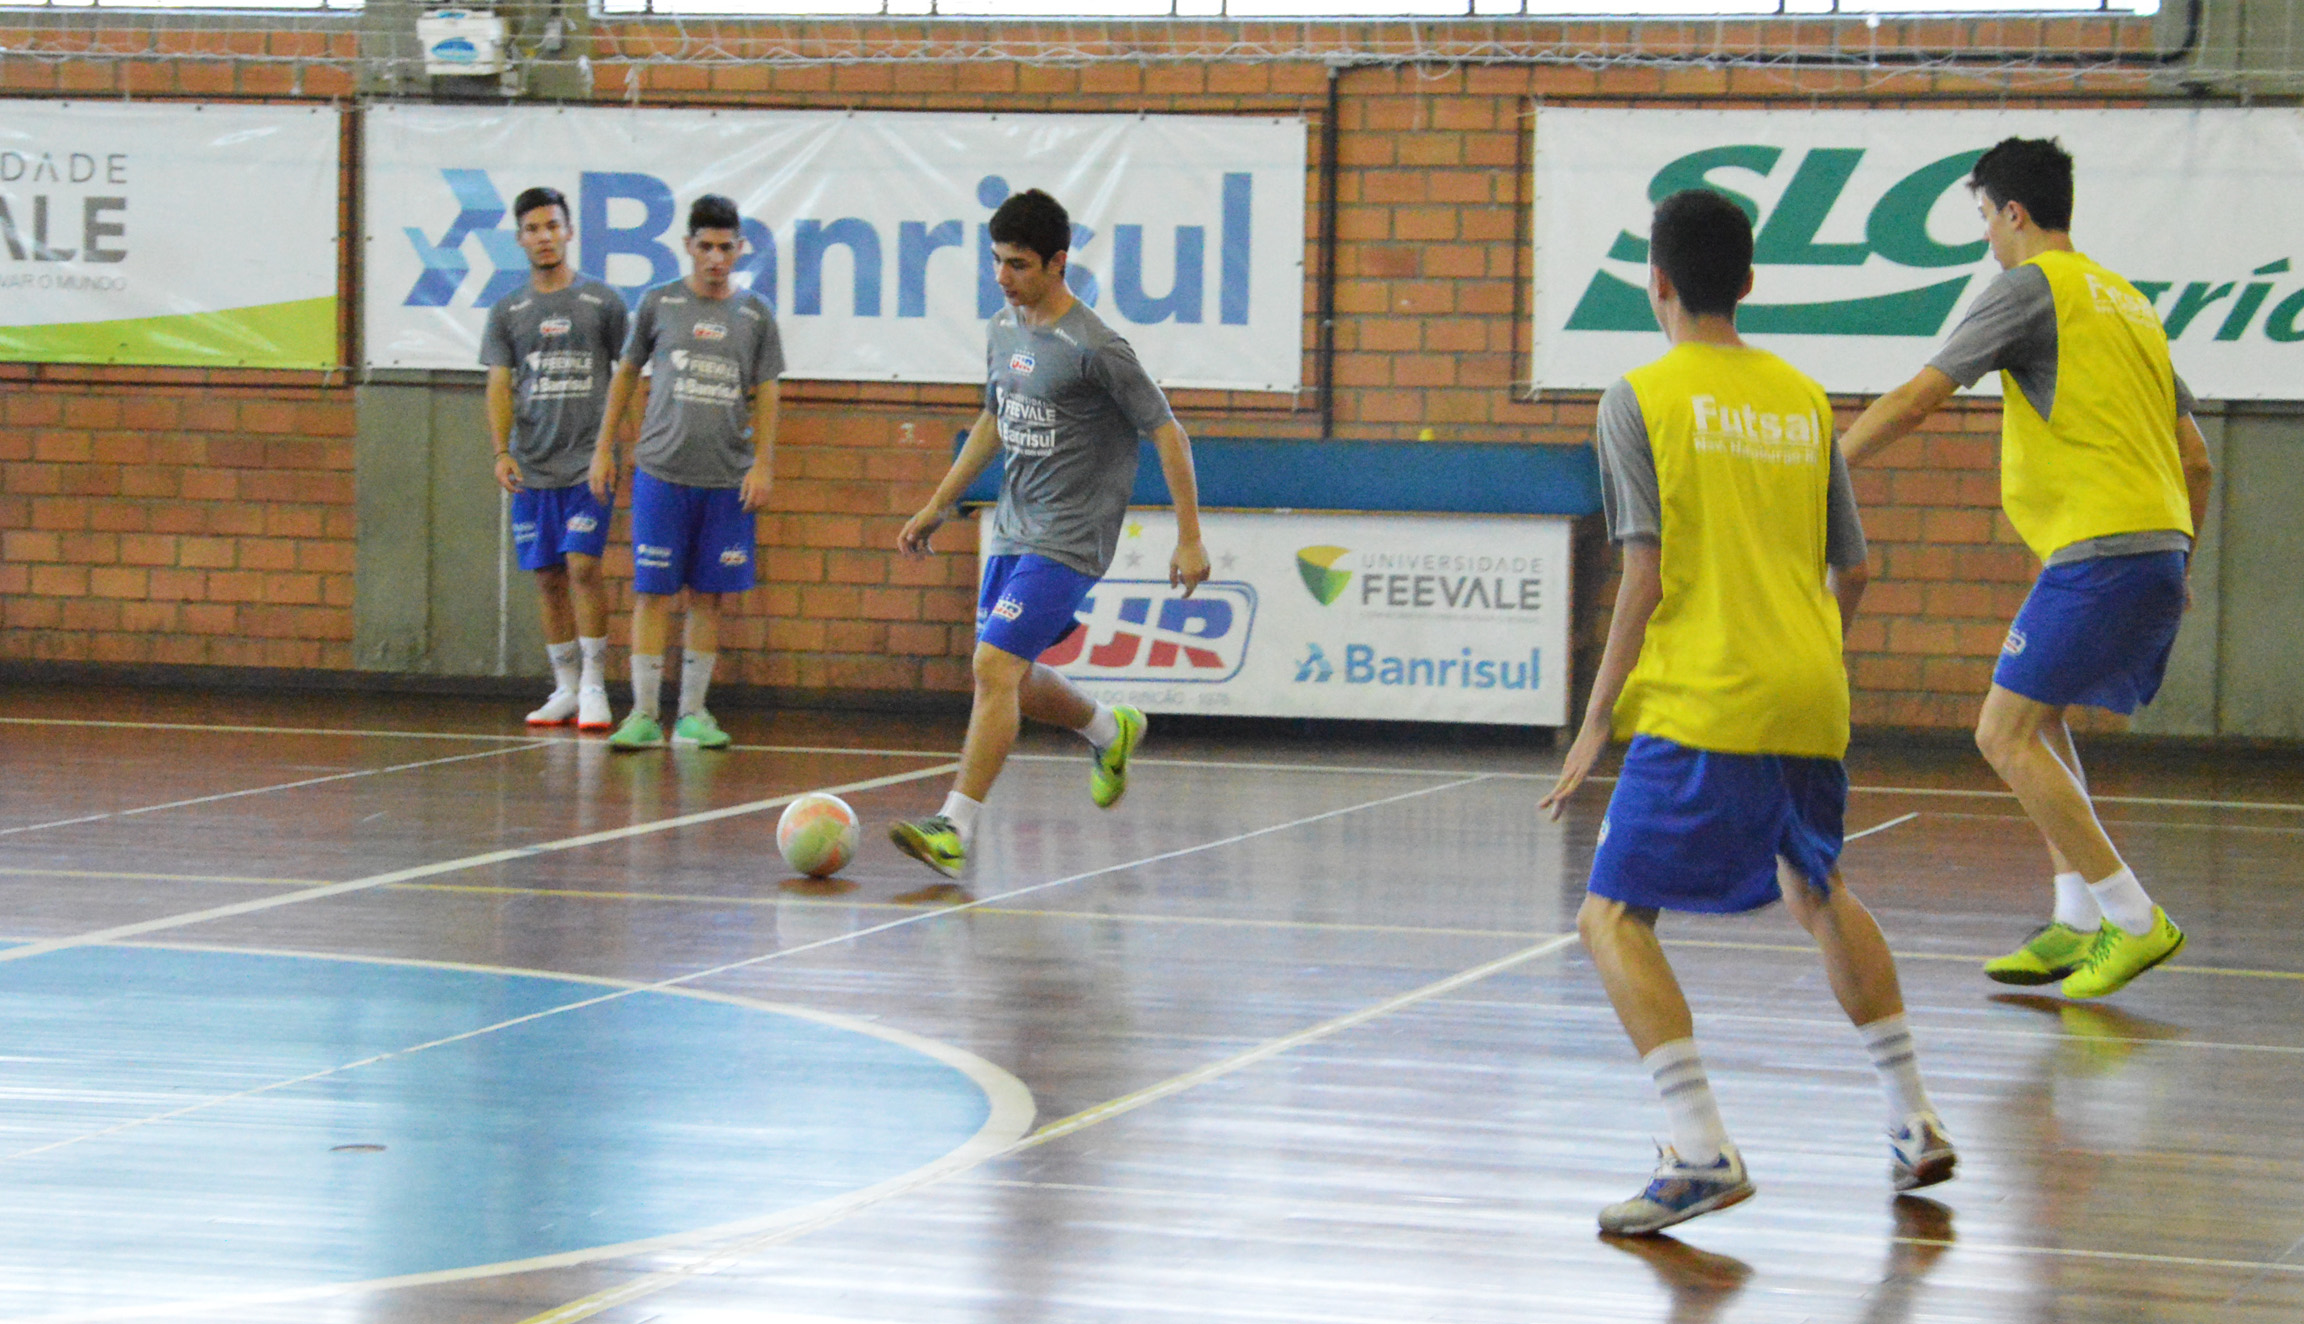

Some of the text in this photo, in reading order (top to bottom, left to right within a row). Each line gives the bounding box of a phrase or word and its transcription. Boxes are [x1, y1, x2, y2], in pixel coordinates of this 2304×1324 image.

[1606, 144, 1991, 268] SLC
[1691, 393, 1819, 445] Futsal
[1361, 553, 1544, 574] UNIVERSIDADE
[1361, 573, 1542, 610] FEEVALE
[1345, 642, 1542, 690] Banrisul
